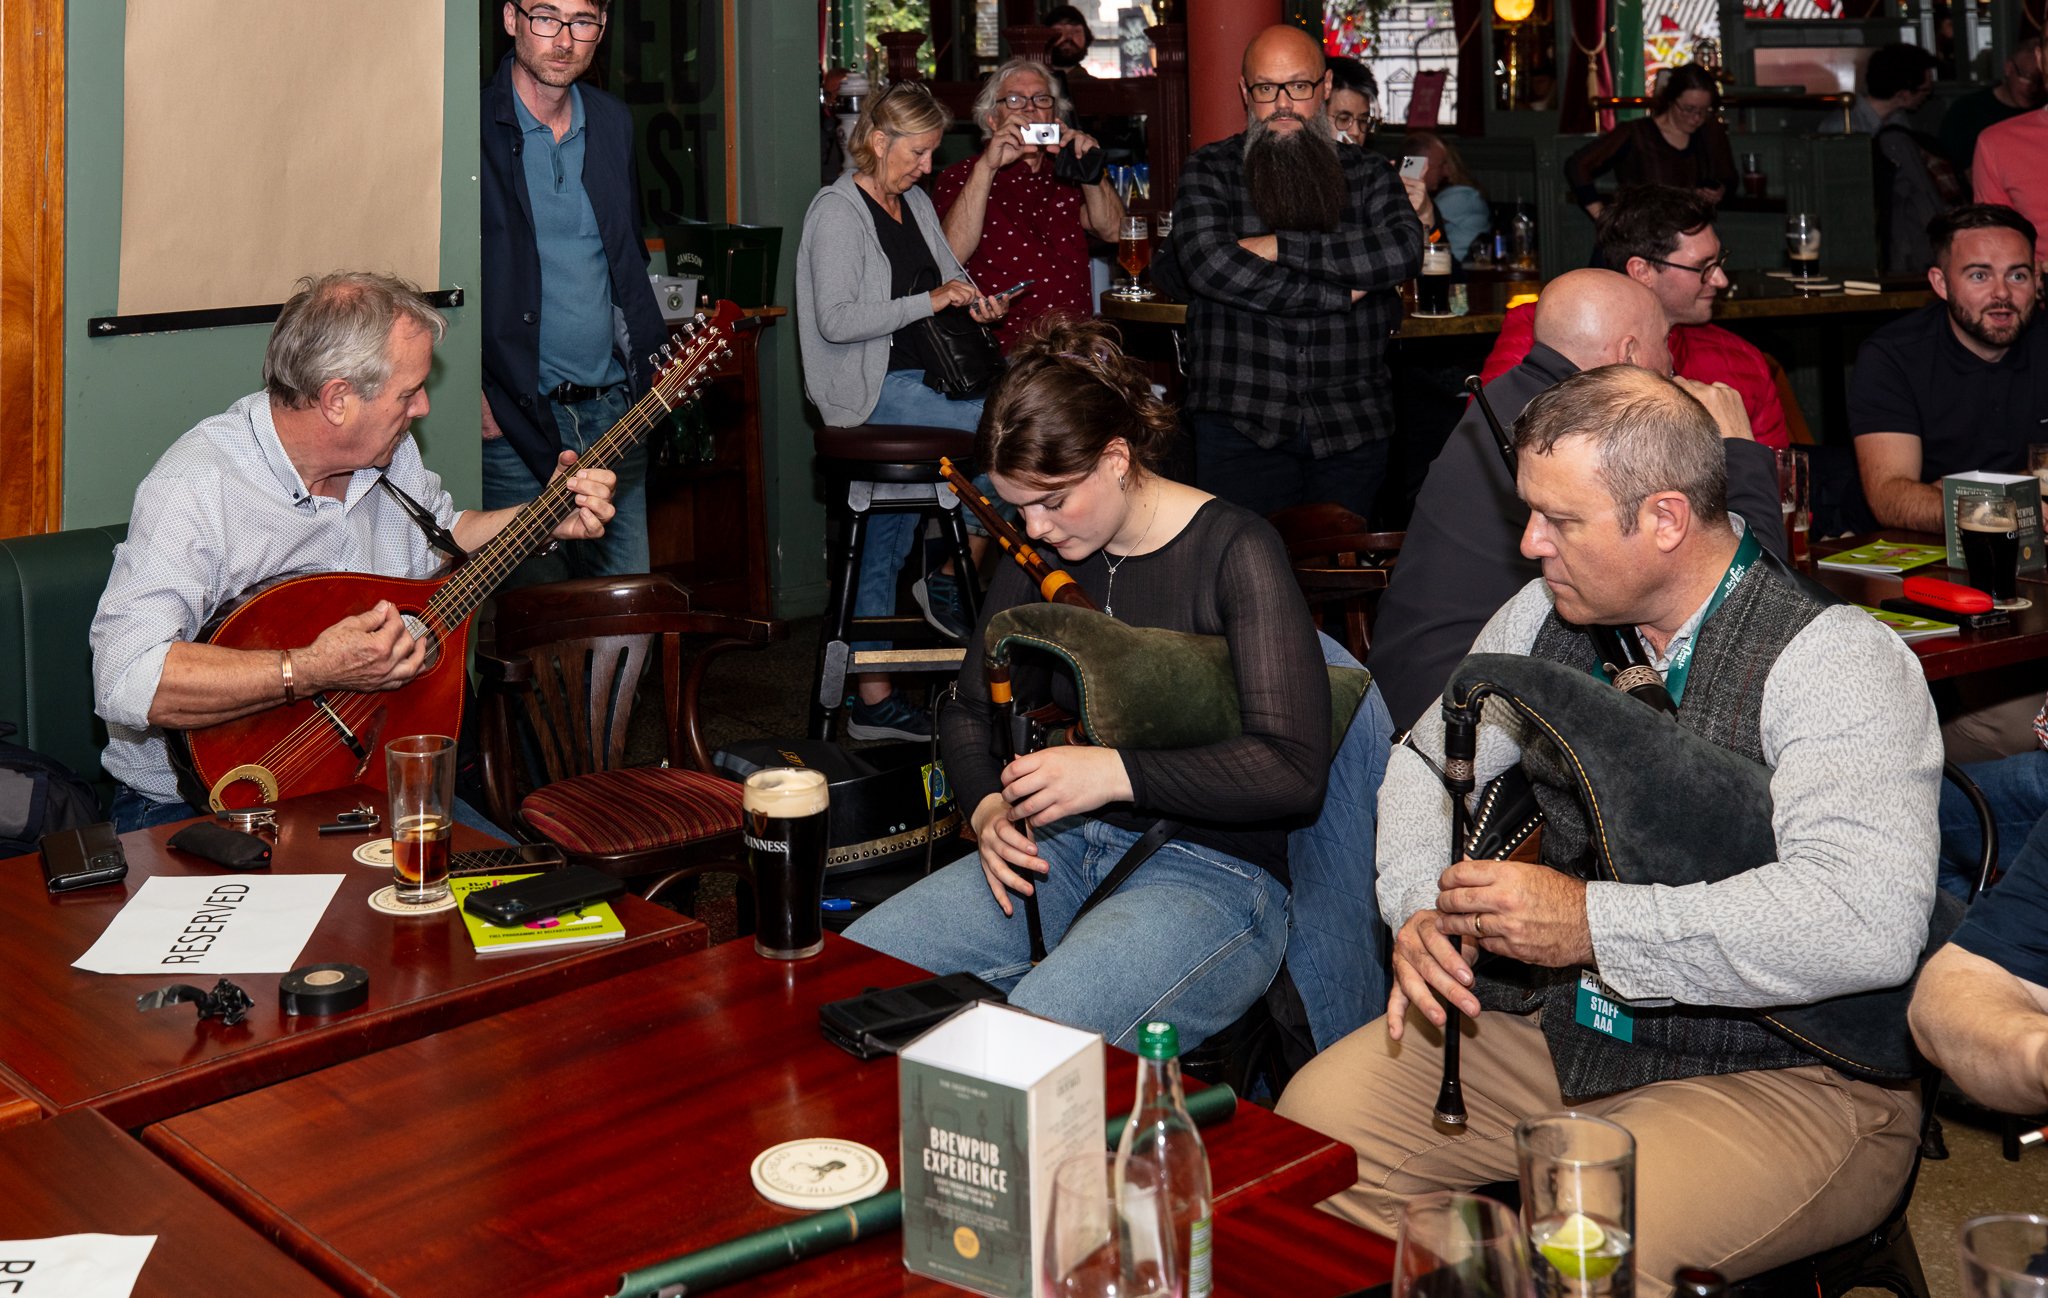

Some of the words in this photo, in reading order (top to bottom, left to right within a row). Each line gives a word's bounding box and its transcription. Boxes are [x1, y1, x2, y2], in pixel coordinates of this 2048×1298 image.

[677, 252, 704, 268] JAMESON
[161, 884, 250, 965] RESERVED
[1590, 996, 1620, 1019] STAFF
[1593, 1013, 1613, 1034] AAA
[930, 1126, 1000, 1167] BREWPUB
[923, 1147, 1008, 1194] EXPERIENCE
